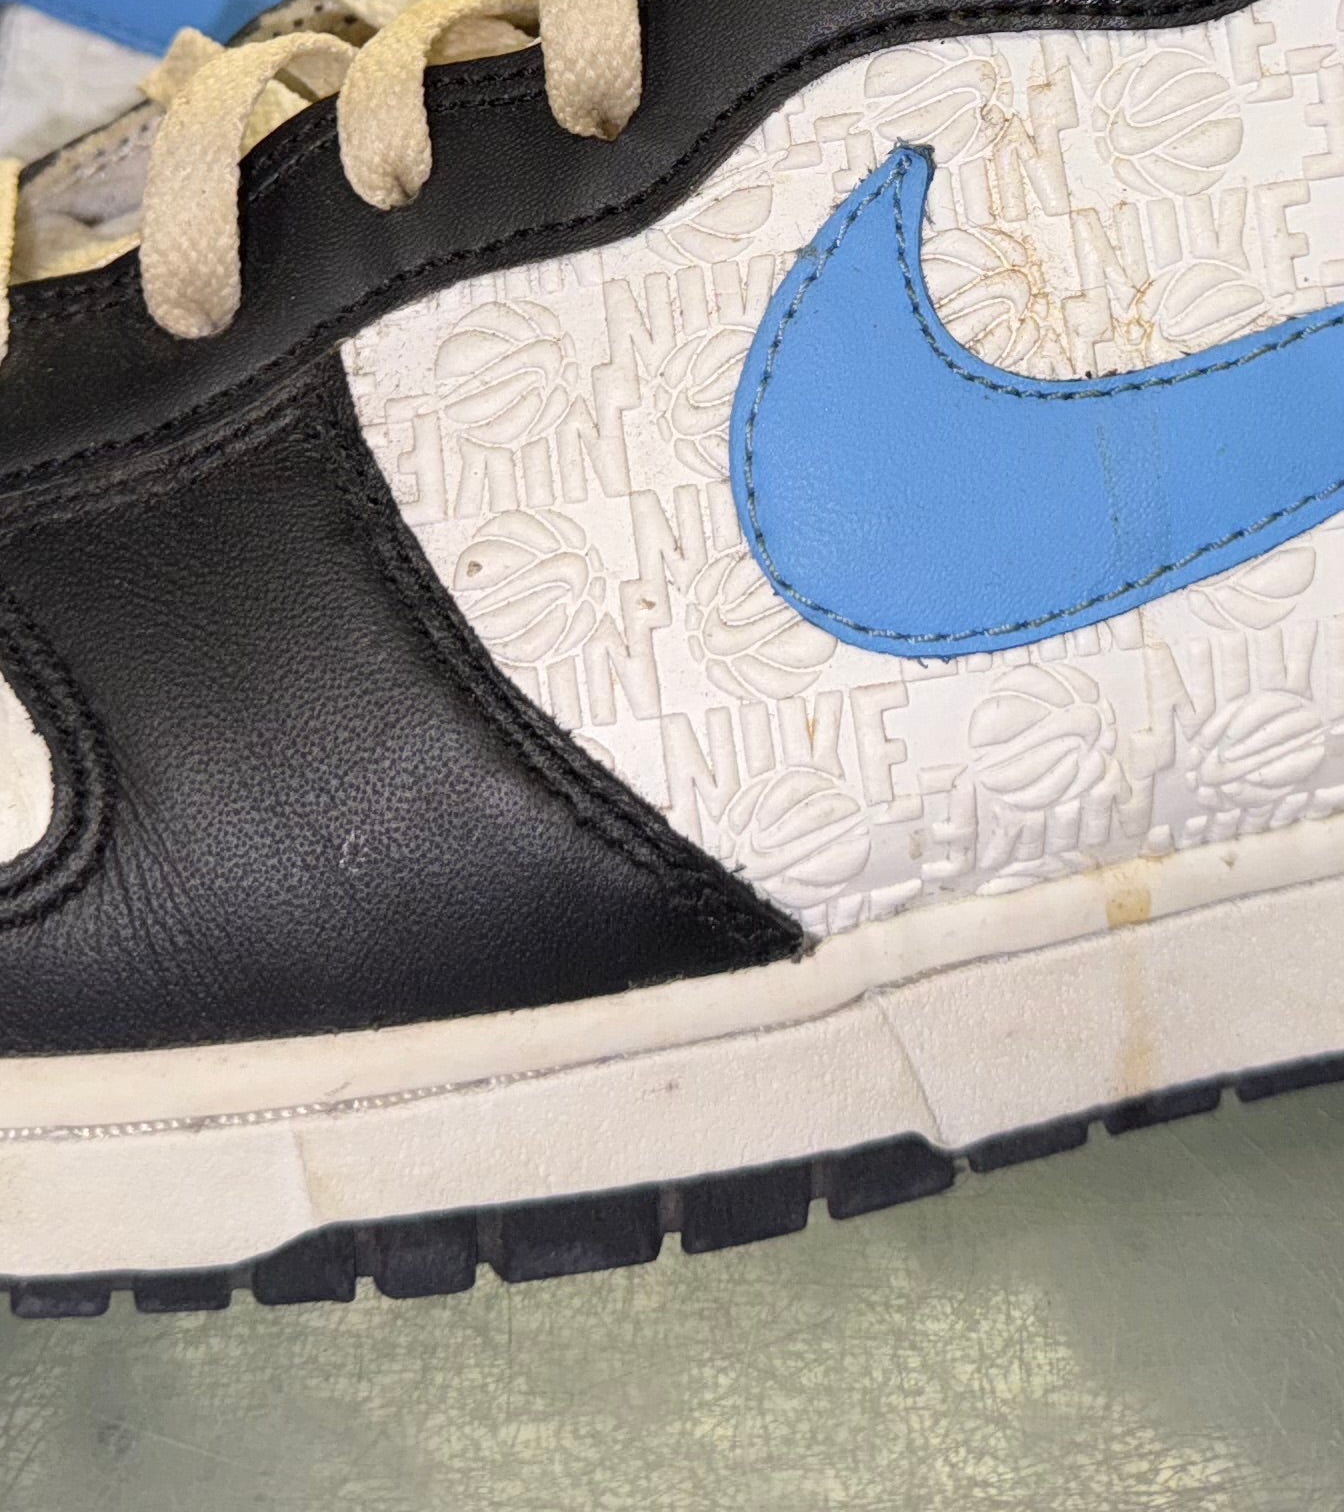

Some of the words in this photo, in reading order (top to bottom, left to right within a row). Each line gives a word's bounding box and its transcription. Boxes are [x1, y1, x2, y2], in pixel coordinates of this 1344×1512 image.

[1071, 178, 1328, 326] NIKE
[384, 366, 632, 525] NIKE
[659, 681, 924, 846] NIKE
